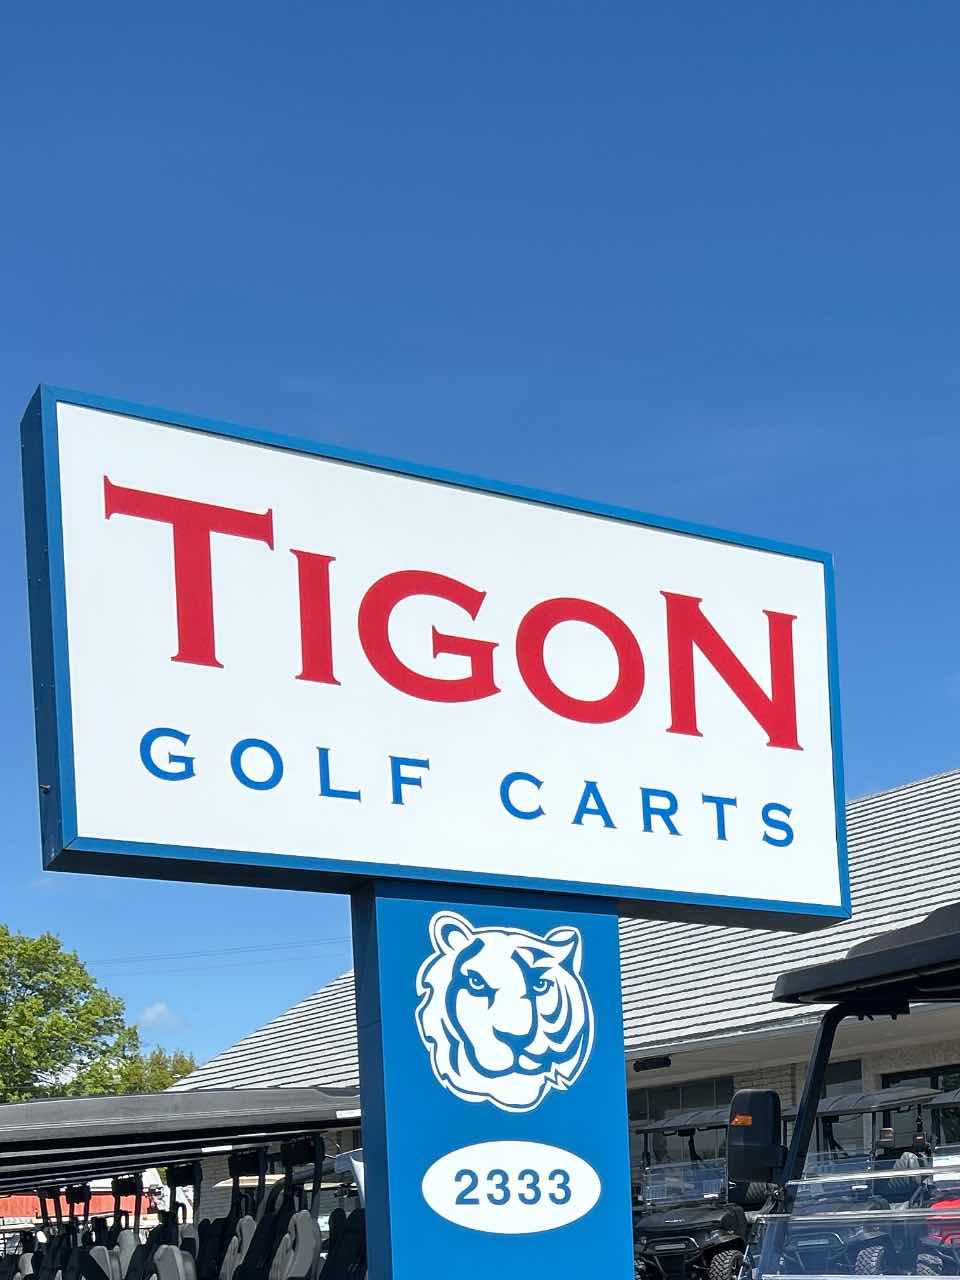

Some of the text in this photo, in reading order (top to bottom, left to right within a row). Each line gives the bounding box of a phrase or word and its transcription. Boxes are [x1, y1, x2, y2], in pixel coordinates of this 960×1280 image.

[103, 475, 803, 752] TIGON
[139, 726, 795, 849] GOLF CARTS
[454, 1168, 572, 1206] 2333
